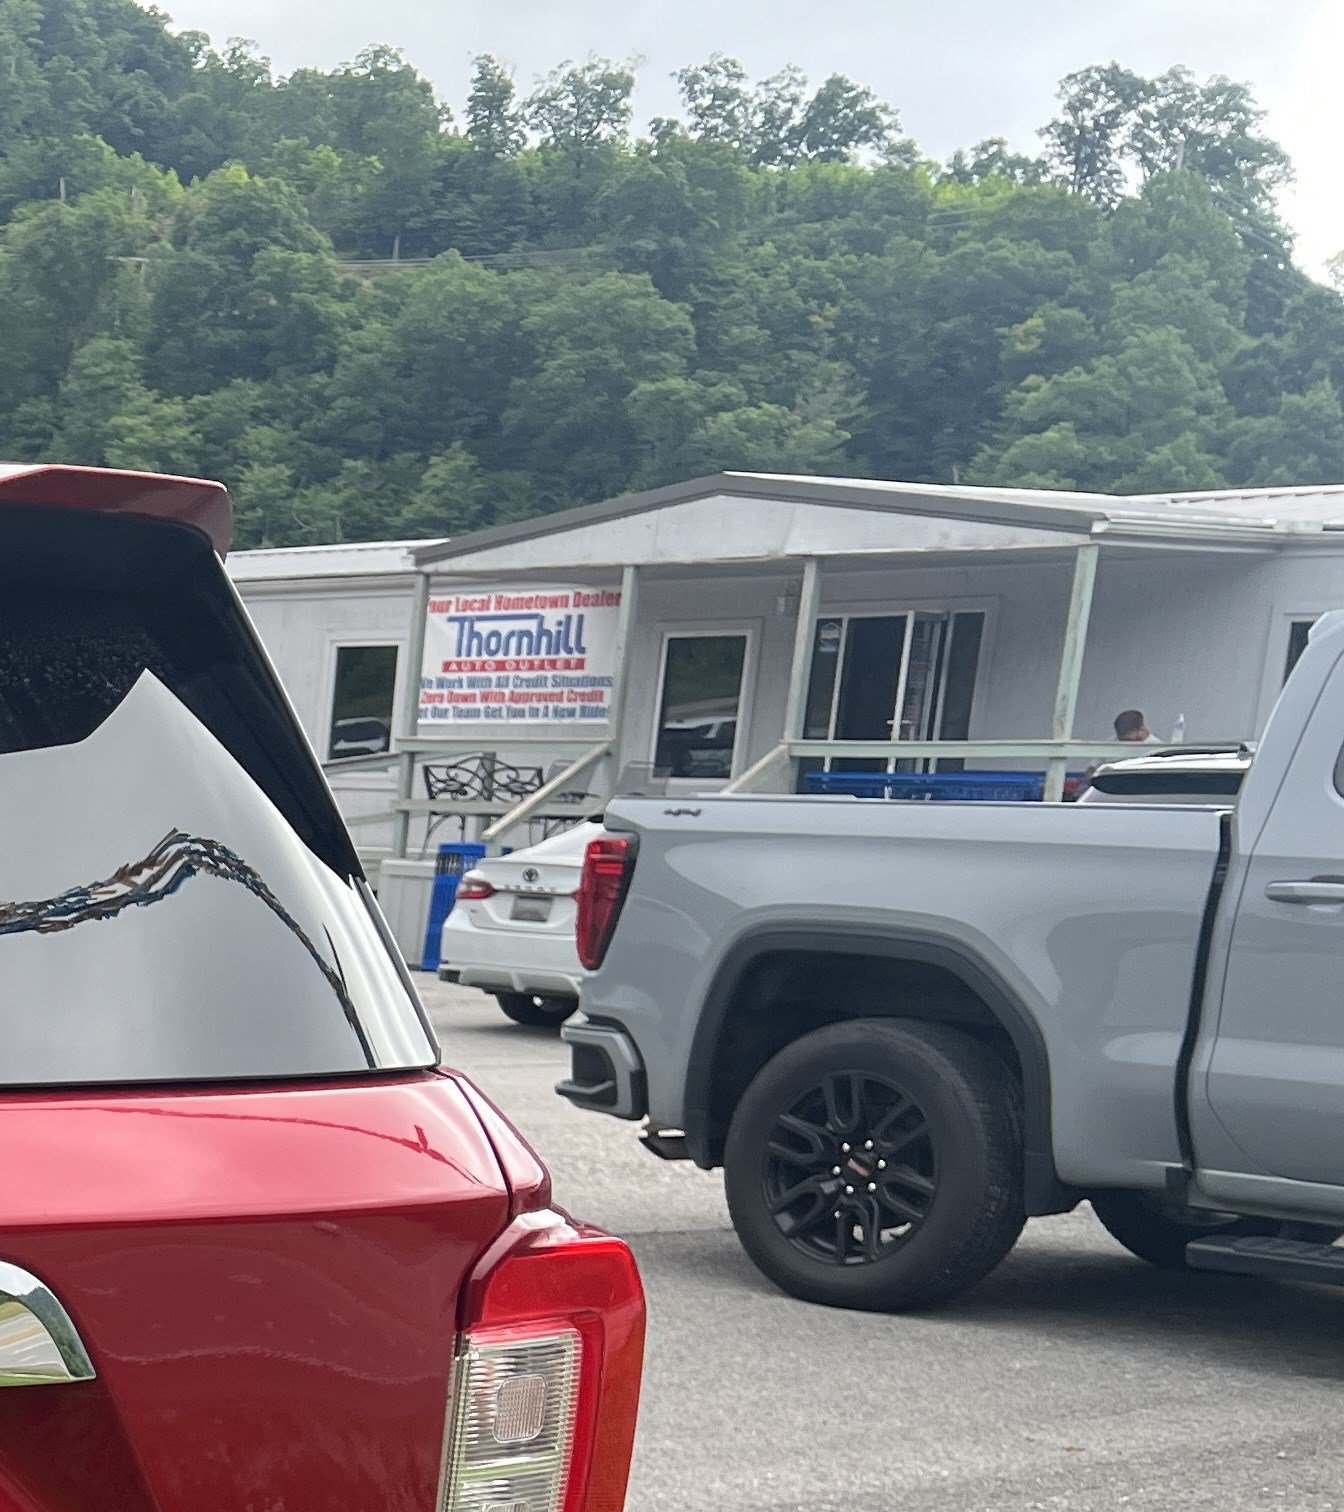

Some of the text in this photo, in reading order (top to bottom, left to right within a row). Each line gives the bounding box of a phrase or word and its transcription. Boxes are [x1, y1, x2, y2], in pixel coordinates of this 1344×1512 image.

[428, 599, 452, 613] our
[455, 595, 492, 612] Local
[494, 594, 570, 611] Hometown
[446, 613, 586, 658] Thornhill
[448, 658, 577, 671] AUTO OUTLET
[436, 676, 464, 689] Work
[466, 675, 492, 688] With
[495, 674, 510, 688] All
[512, 674, 549, 688] Credit
[551, 674, 613, 688] Situations
[420, 689, 604, 704] Zero Down With Approved Credit
[431, 705, 450, 718] Our
[452, 705, 481, 718] Team
[484, 704, 503, 718] Get
[505, 704, 525, 718] You
[542, 705, 549, 717] A
[552, 704, 576, 717] New
